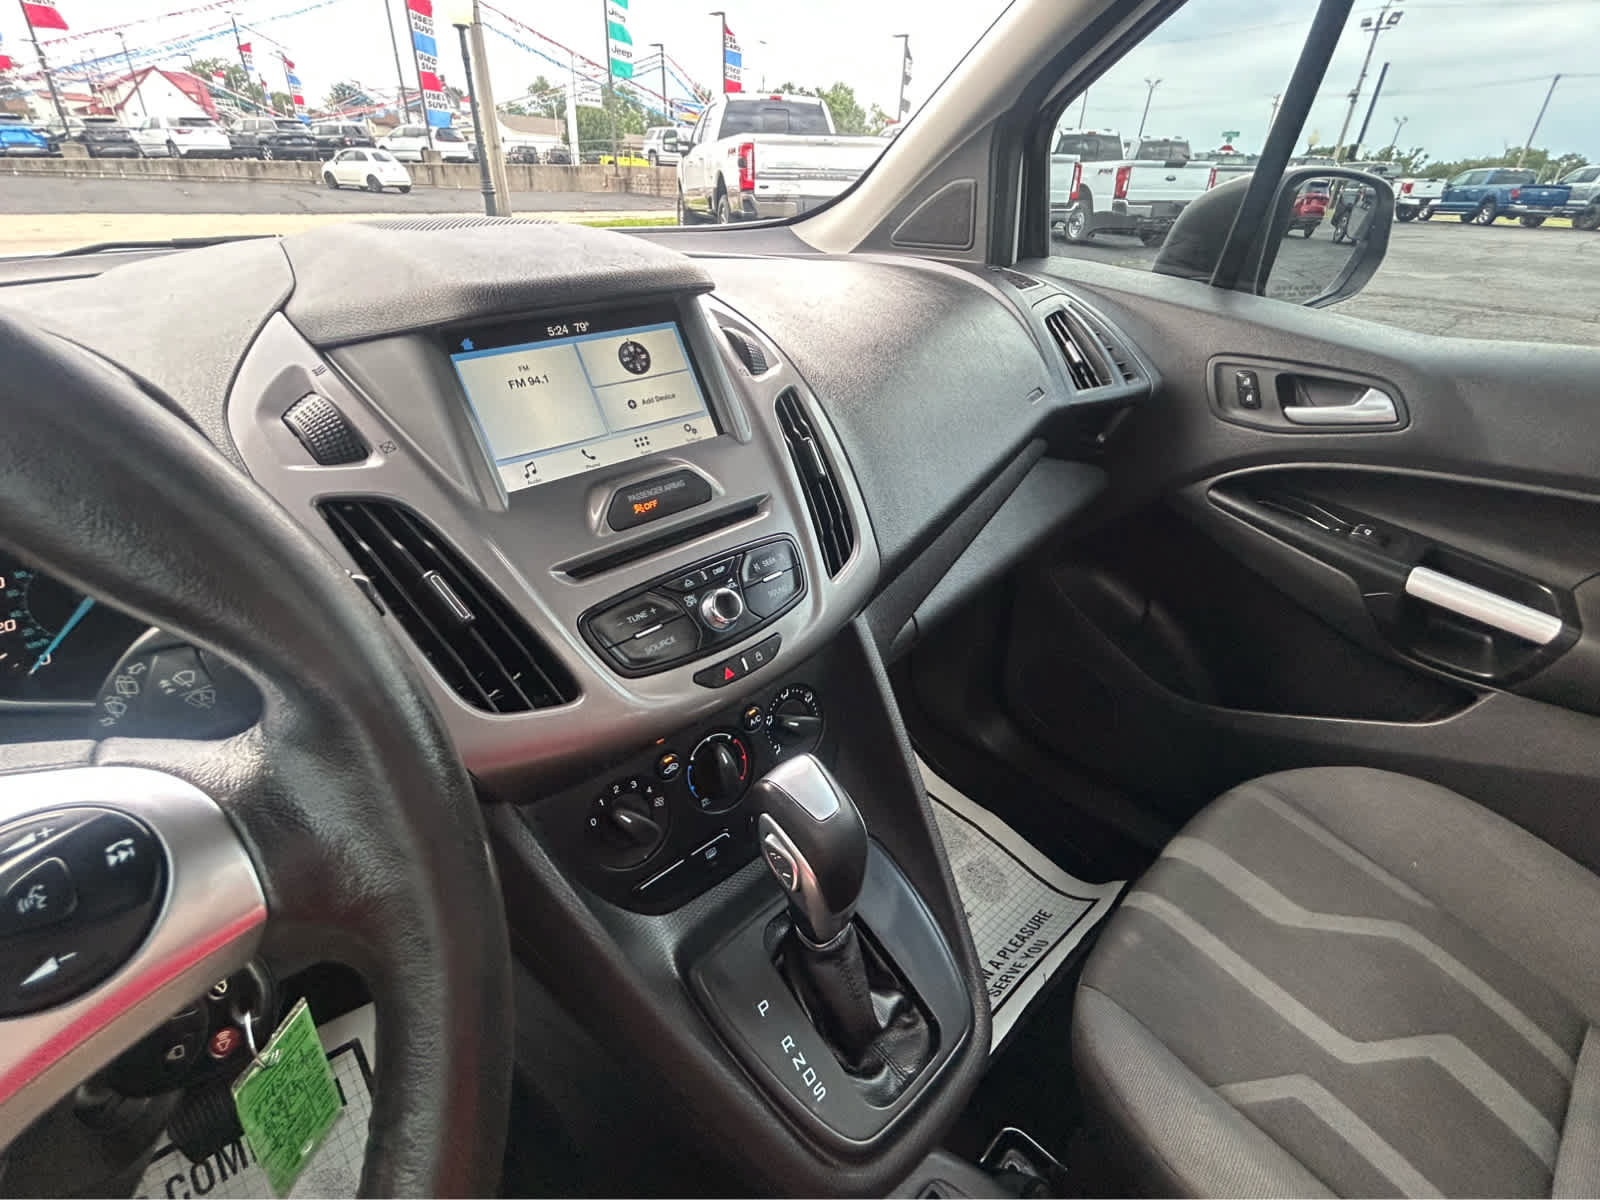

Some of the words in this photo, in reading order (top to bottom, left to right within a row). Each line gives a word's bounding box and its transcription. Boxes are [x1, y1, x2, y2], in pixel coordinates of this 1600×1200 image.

[411, 12, 433, 26] USED
[611, 45, 633, 58] Jeep
[547, 324, 568, 337] 5:24
[518, 364, 529, 372] FM
[508, 377, 527, 390] FM
[528, 374, 549, 386] 94.1
[644, 500, 658, 511] OFF
[626, 609, 649, 624] TUNE
[644, 635, 676, 656] SOURCE
[749, 715, 762, 726] A/C
[613, 785, 620, 795] 2
[631, 780, 637, 789] 3
[590, 817, 597, 827] 0
[988, 960, 1005, 970] A
[997, 909, 1053, 960] PLEASURE
[988, 961, 1028, 997] SERVE
[1020, 939, 1049, 959] YOU
[757, 999, 769, 1017] P
[781, 1035, 795, 1053] R
[792, 1052, 807, 1071] N
[802, 1067, 817, 1087] D
[813, 1081, 827, 1102] S
